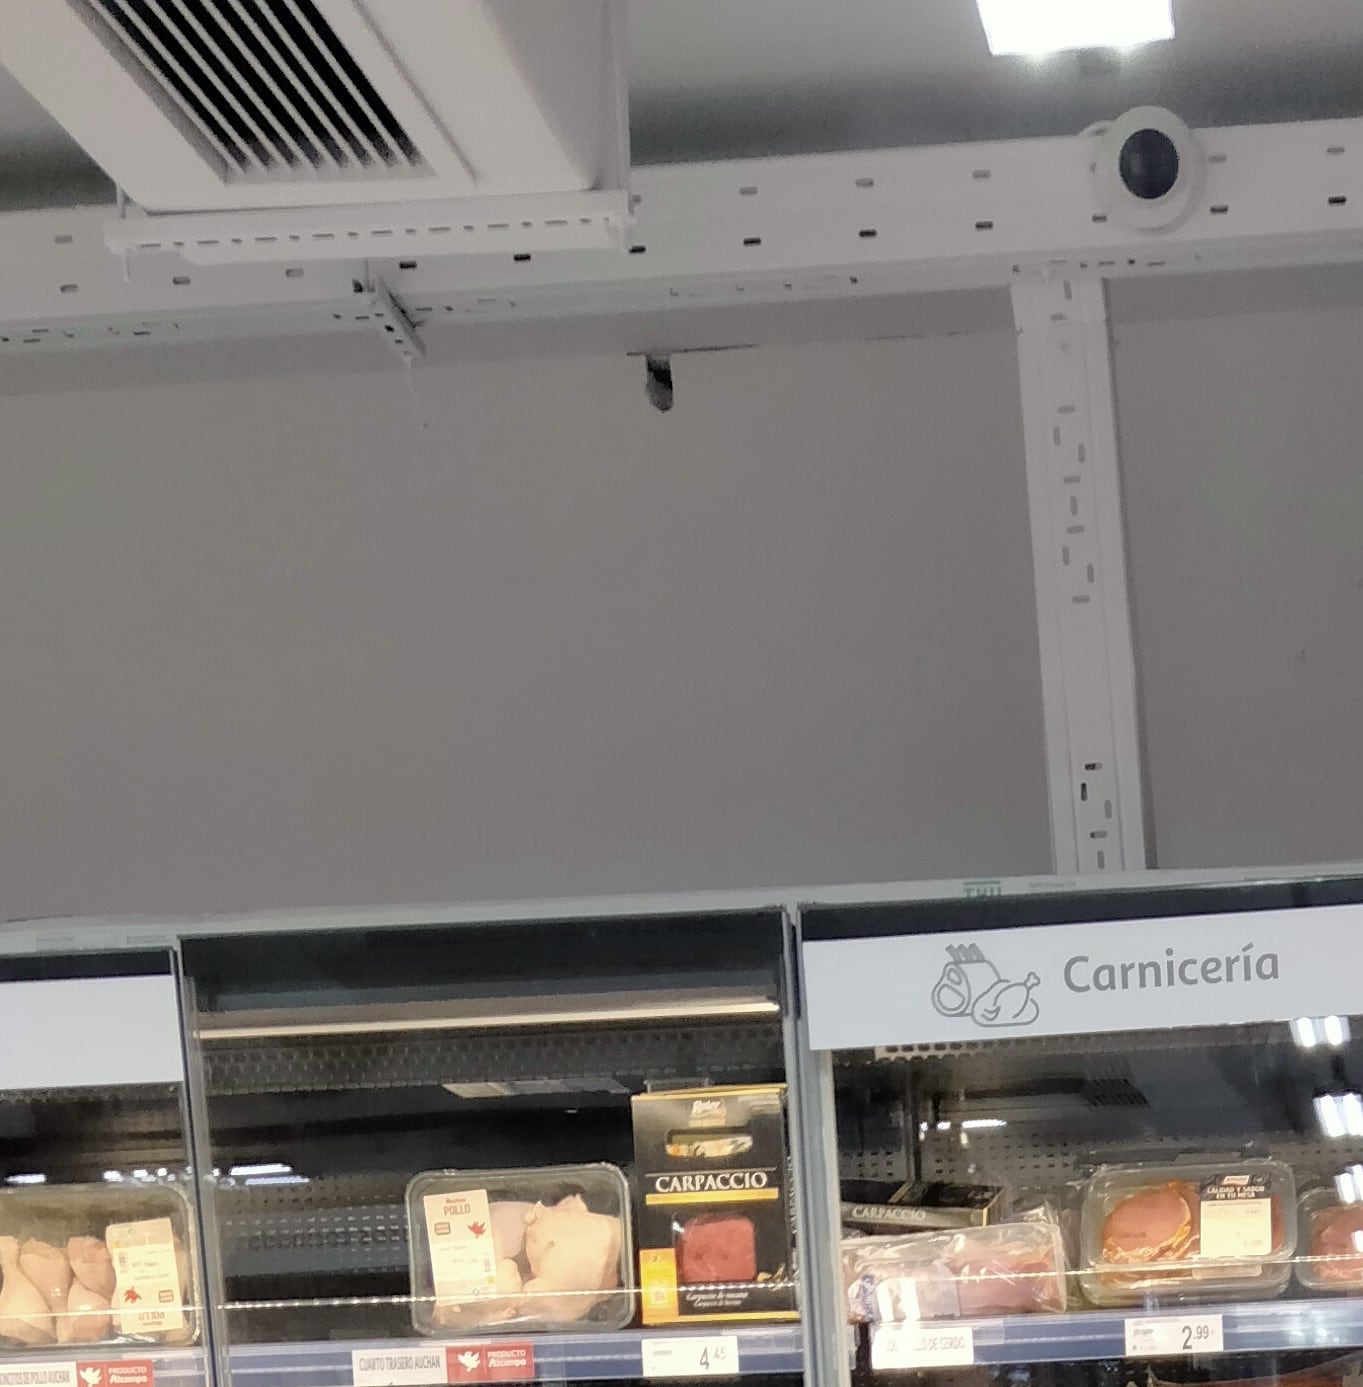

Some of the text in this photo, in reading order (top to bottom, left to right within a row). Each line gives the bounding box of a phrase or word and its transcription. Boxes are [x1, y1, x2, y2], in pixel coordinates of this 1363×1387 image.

[1063, 942, 1280, 994] Carnicería
[655, 1171, 768, 1193] CARPACCIO
[443, 1204, 471, 1216] POLLO
[487, 1349, 526, 1358] PRODUCTO
[359, 1355, 440, 1372] CUARTO TRASERO AUCHAN
[488, 1358, 527, 1368] Alcampo
[108, 1366, 147, 1375] PRODUCTO
[109, 1375, 148, 1384] Alcampo
